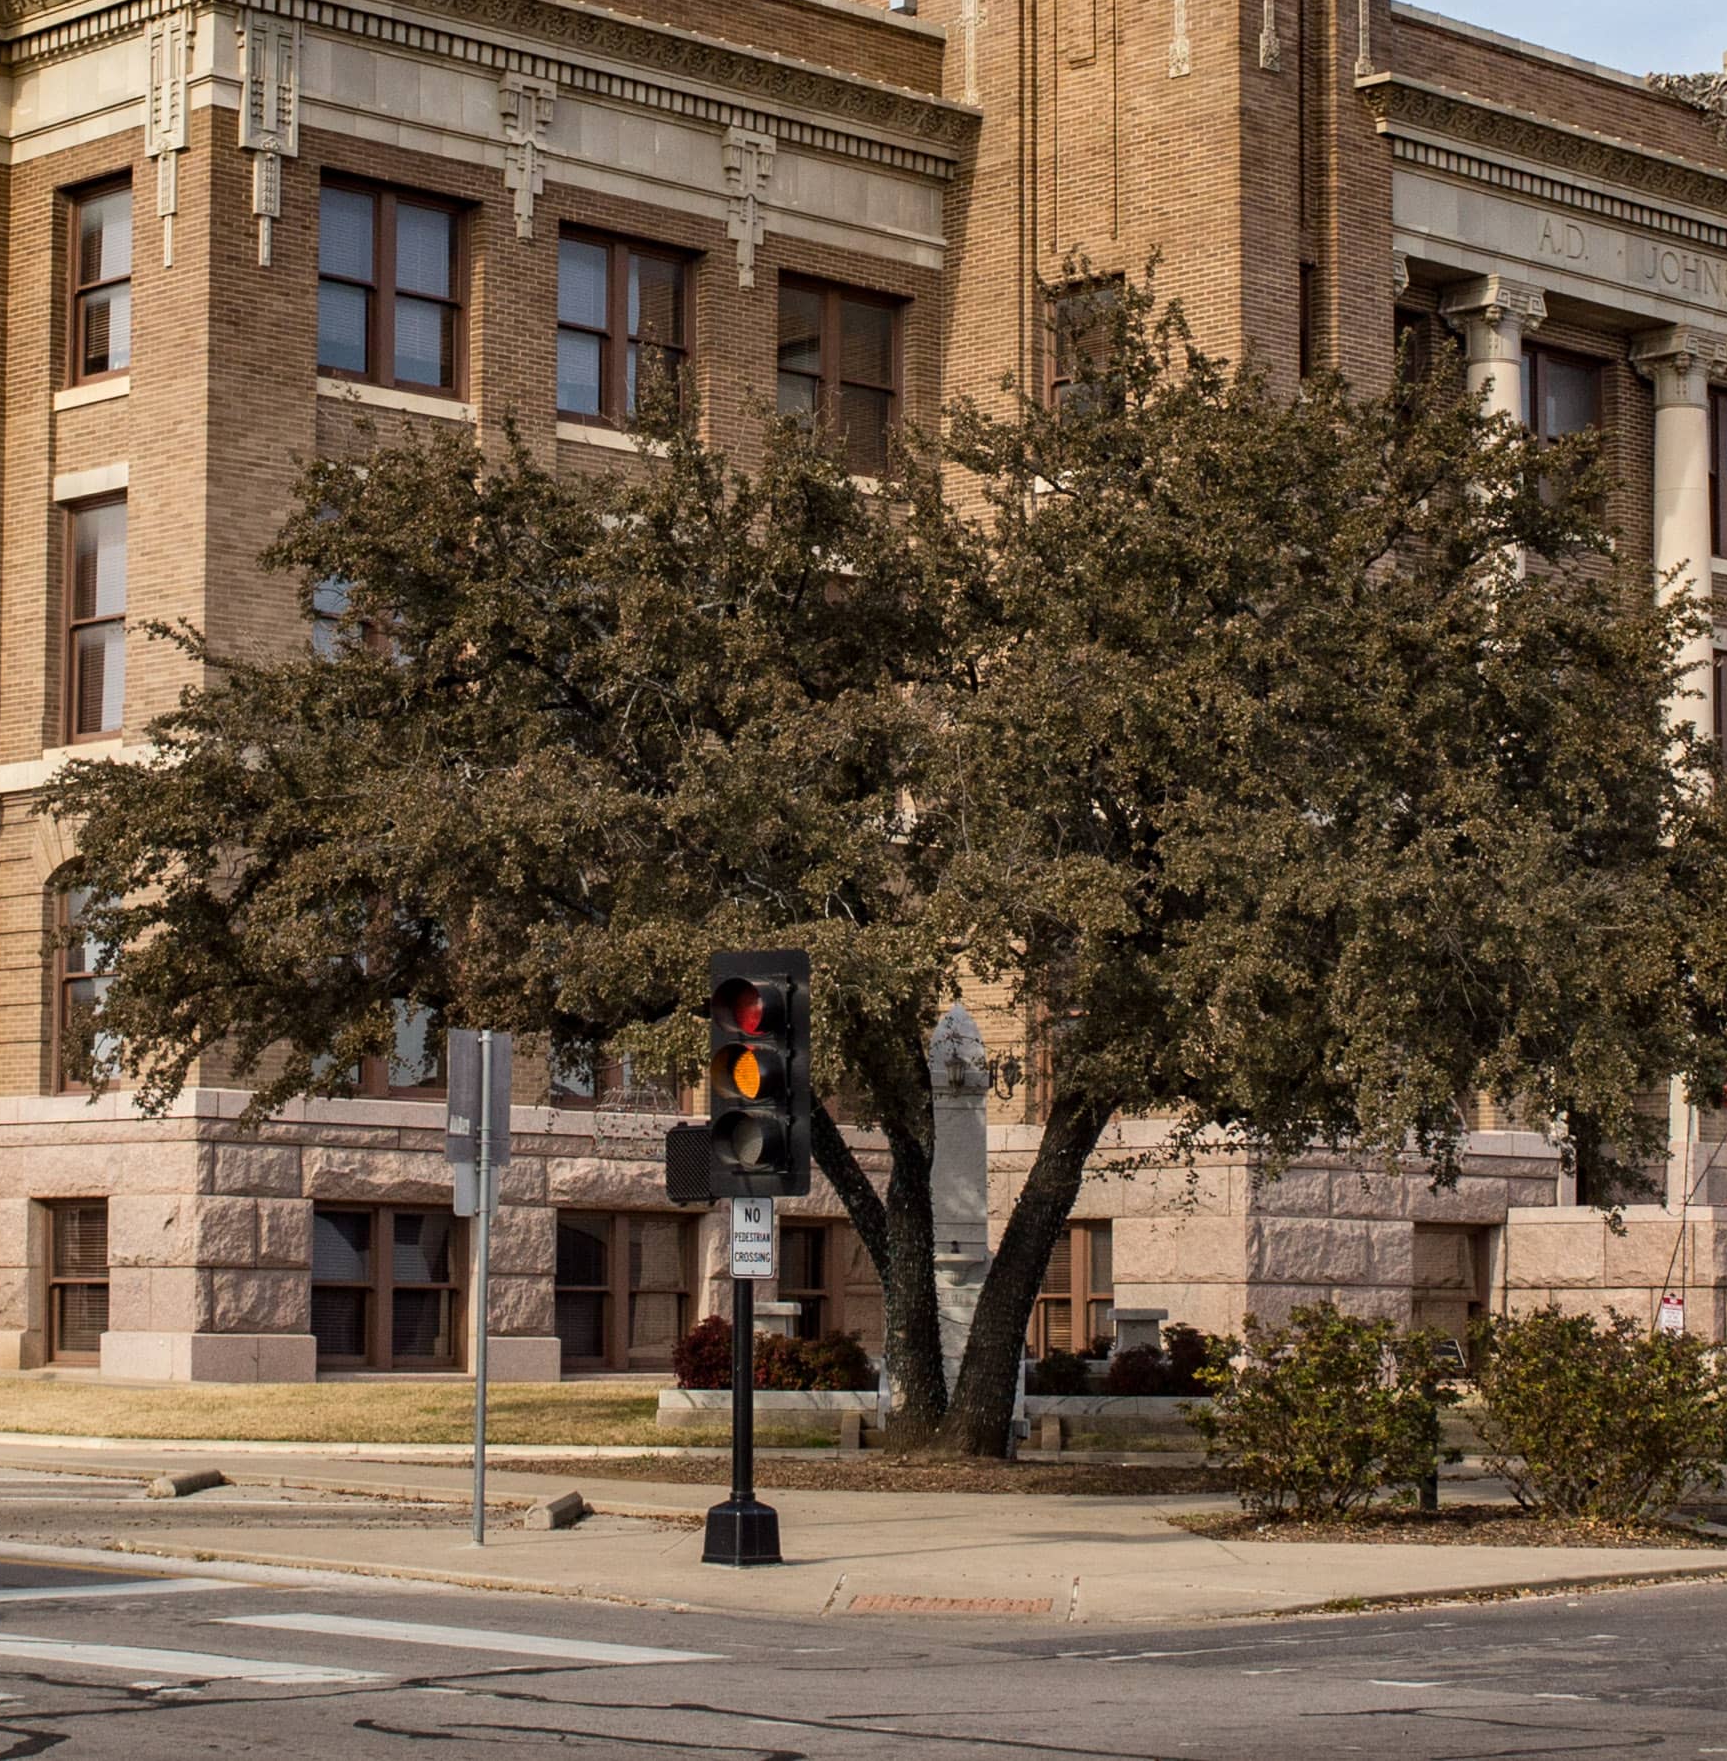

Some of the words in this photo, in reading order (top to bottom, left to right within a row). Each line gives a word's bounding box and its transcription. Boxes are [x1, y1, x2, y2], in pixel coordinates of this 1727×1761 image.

[1539, 217, 1589, 261] A.D.
[745, 1207, 761, 1224] NO
[735, 1231, 771, 1243] PEDESTRIAN
[735, 1252, 771, 1263] CROSSING
